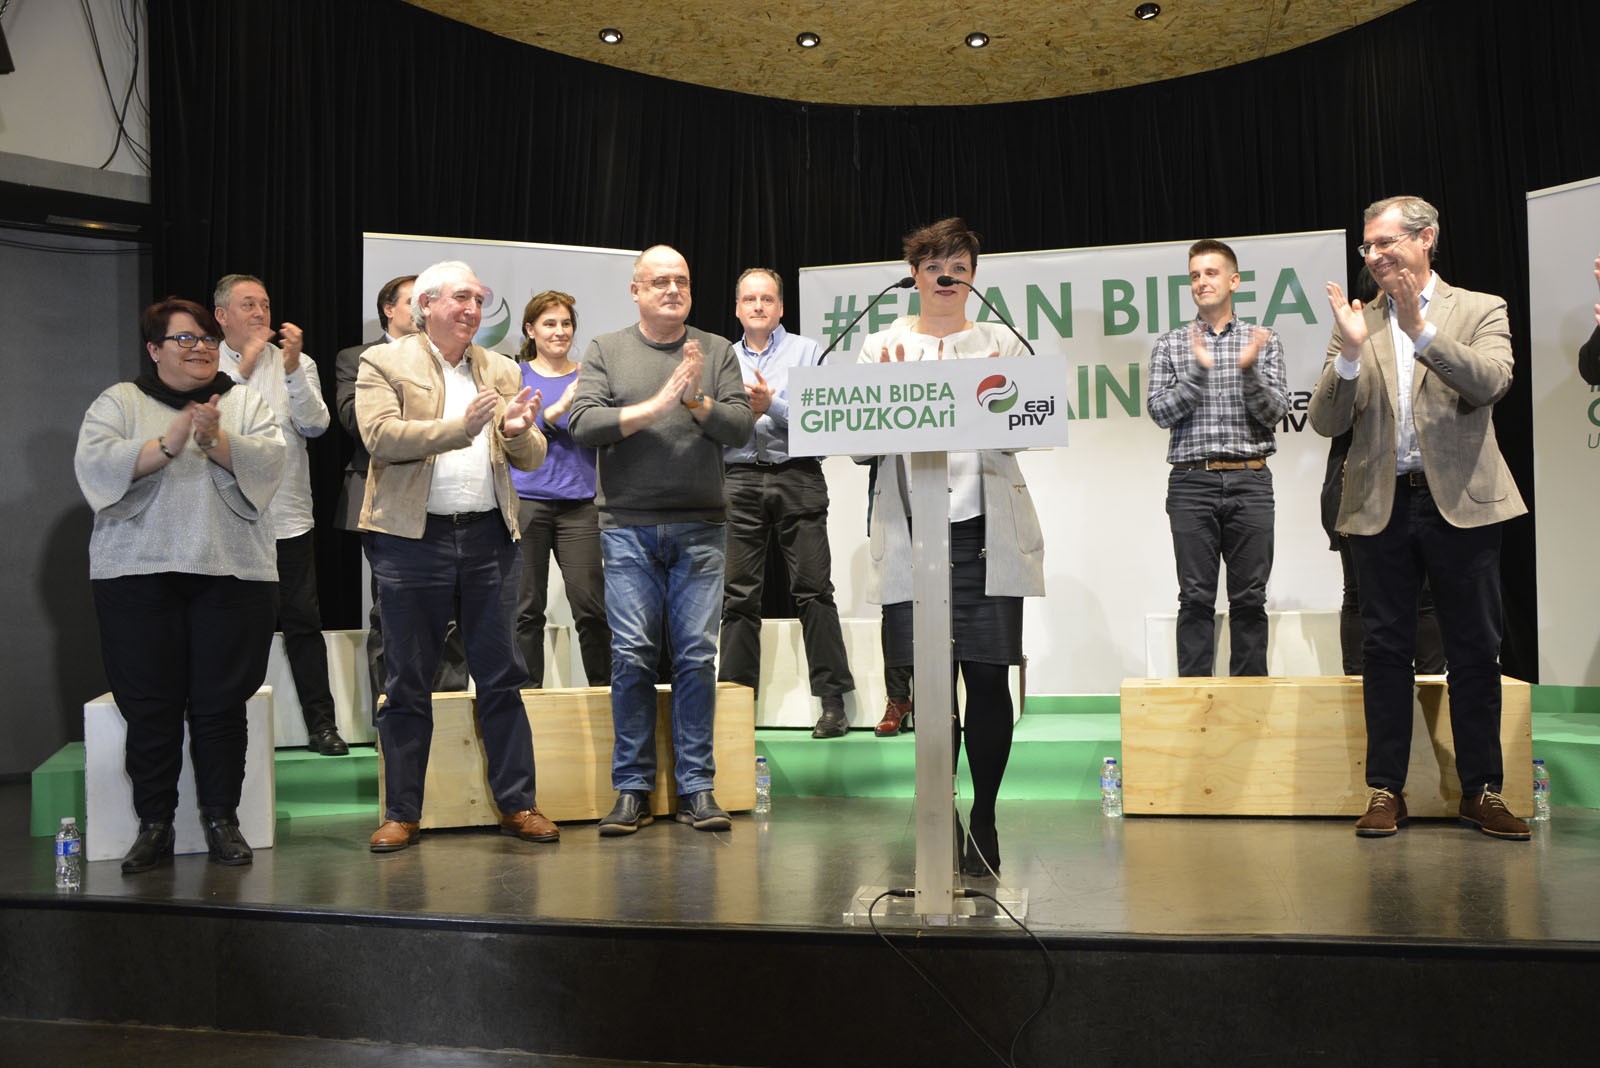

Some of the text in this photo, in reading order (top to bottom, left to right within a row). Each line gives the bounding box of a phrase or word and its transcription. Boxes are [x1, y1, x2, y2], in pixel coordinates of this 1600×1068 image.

[822, 282, 1073, 352] #EAN
[800, 382, 955, 406] #EMAN BIDEA
[1024, 396, 1054, 416] eaj
[800, 404, 955, 433] GIPUZKOAri
[1008, 413, 1047, 430] pnv
